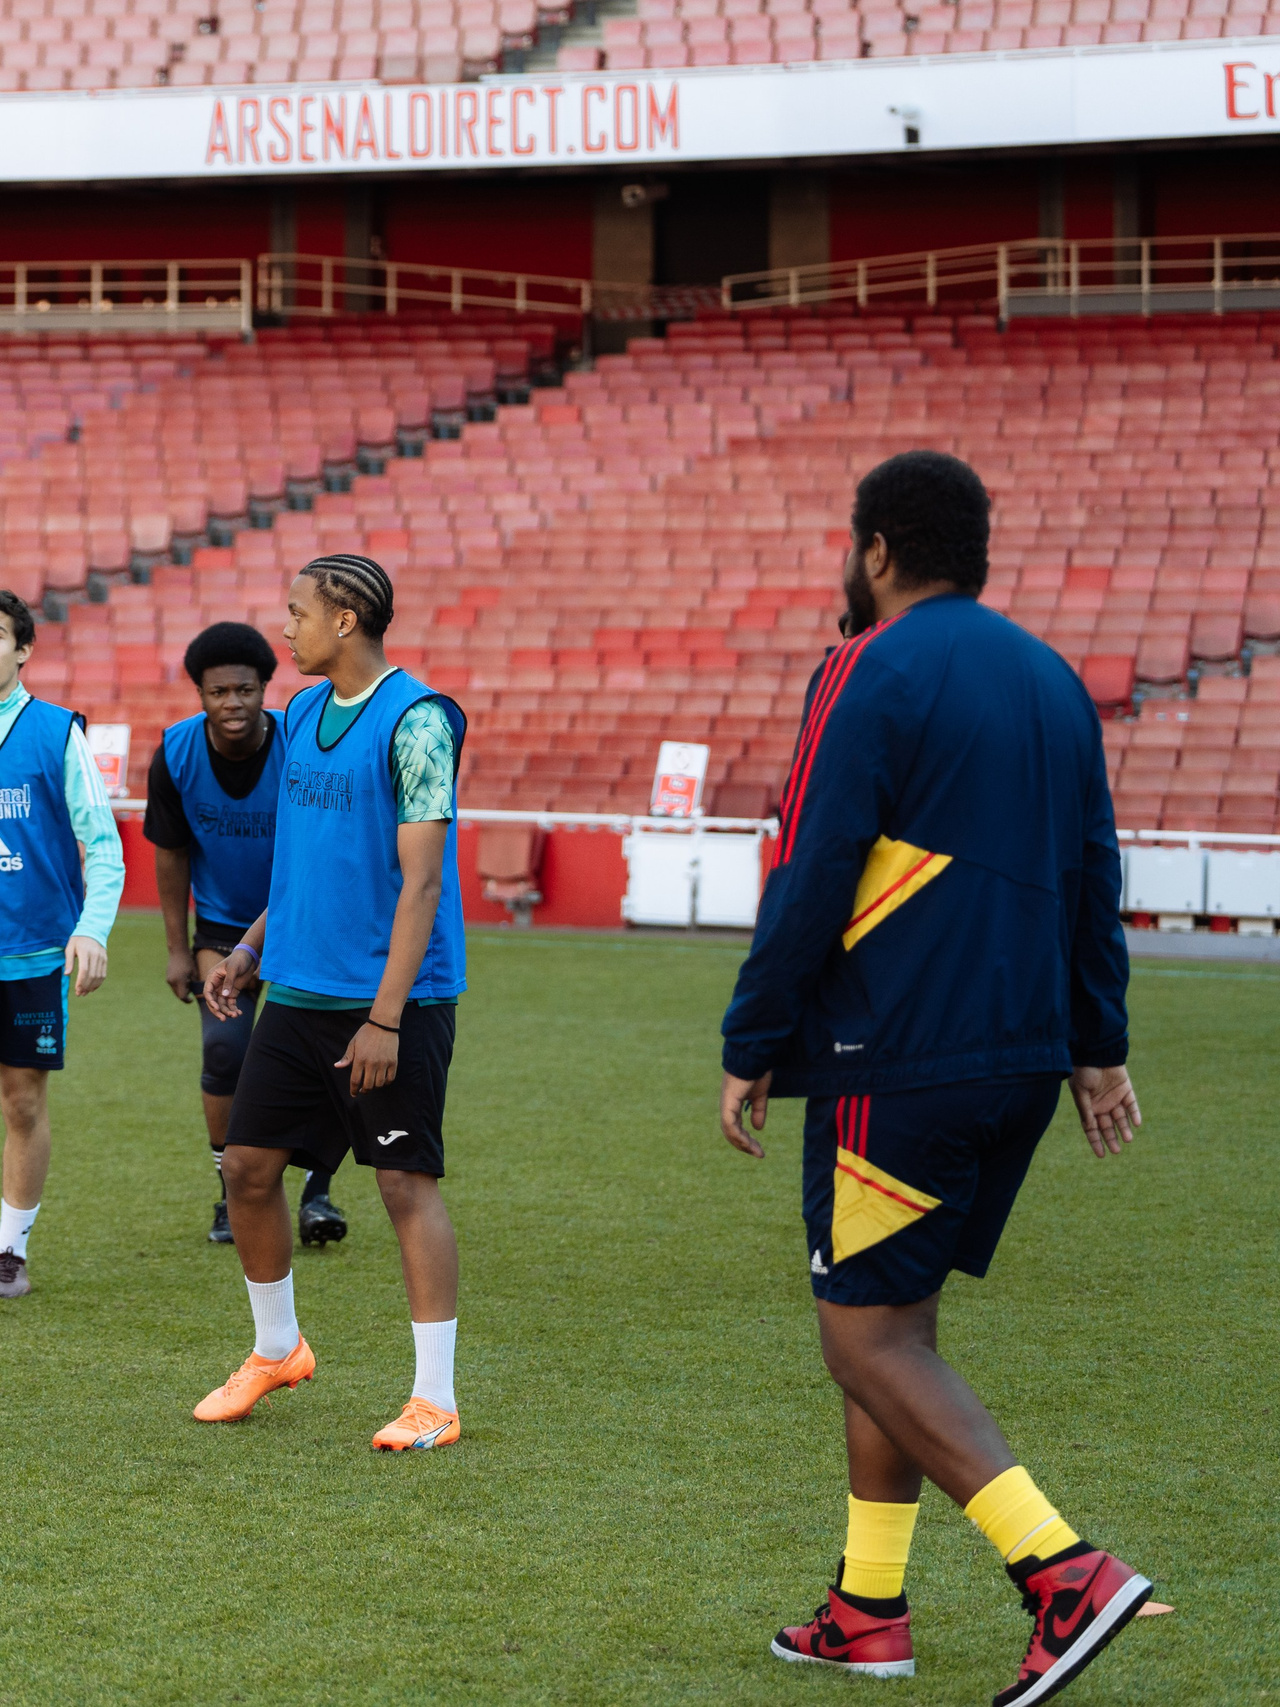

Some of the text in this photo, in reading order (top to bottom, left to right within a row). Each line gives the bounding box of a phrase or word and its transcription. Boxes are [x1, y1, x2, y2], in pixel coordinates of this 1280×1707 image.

[205, 83, 680, 164] ARSENALDIRECT.COM
[299, 763, 354, 794] Arsenal
[298, 788, 353, 812] COMMUNITY
[40, 1025, 52, 1034] A7
